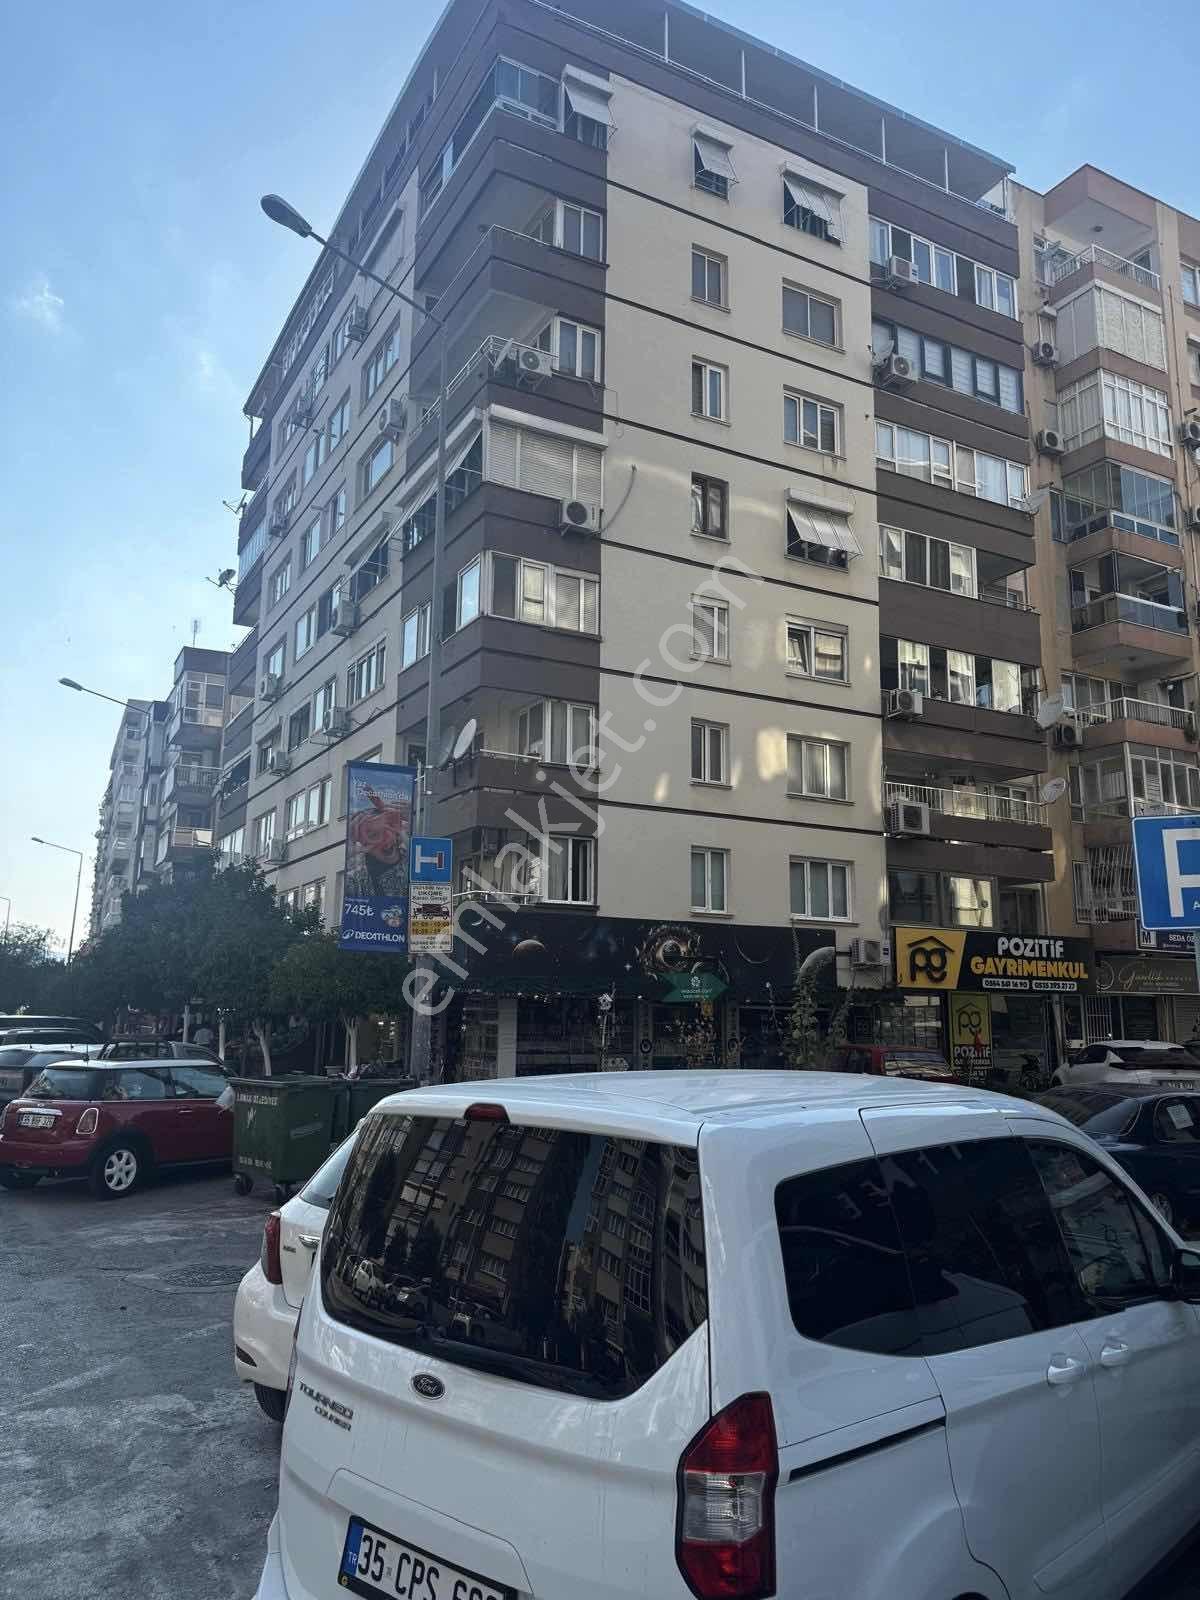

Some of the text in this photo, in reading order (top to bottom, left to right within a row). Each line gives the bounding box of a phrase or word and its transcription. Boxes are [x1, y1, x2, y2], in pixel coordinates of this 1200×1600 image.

[354, 930, 406, 943] DECATHLON
[1168, 934, 1186, 942] SEDA
[970, 957, 1088, 978] GAYRİMENKUL
[416, 1377, 438, 1396] Ford
[299, 1381, 353, 1420] TOURNEO
[358, 1534, 387, 1583] 35
[394, 1552, 440, 1600] CPS
